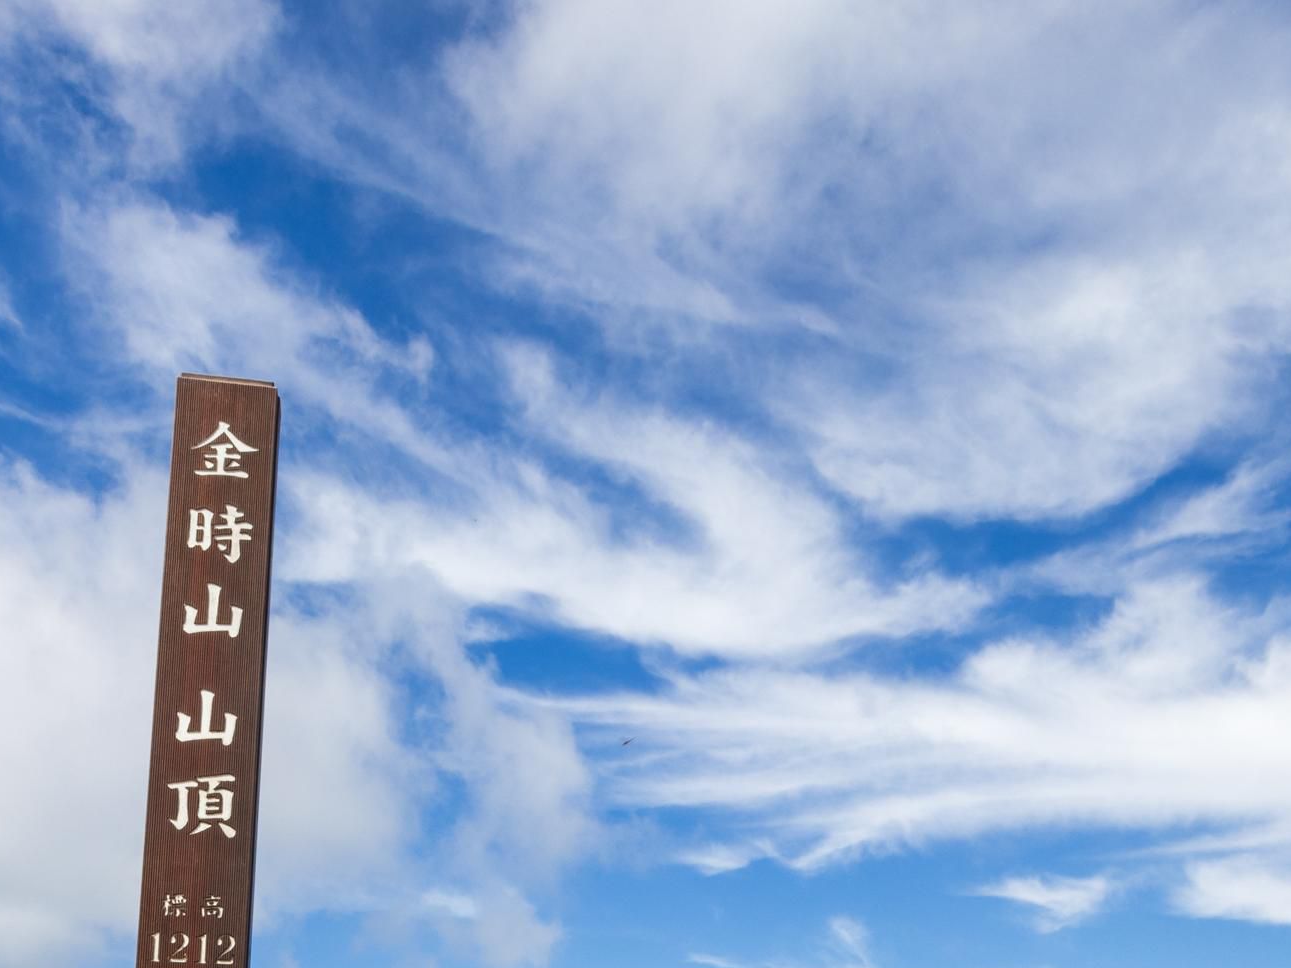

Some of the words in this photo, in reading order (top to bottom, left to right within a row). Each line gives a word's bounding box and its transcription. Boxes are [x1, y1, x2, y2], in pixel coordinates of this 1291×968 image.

[182, 421, 259, 638] 金時山
[167, 689, 238, 839] 山頂
[150, 932, 236, 965] 1212
[162, 894, 224, 919] 標高
